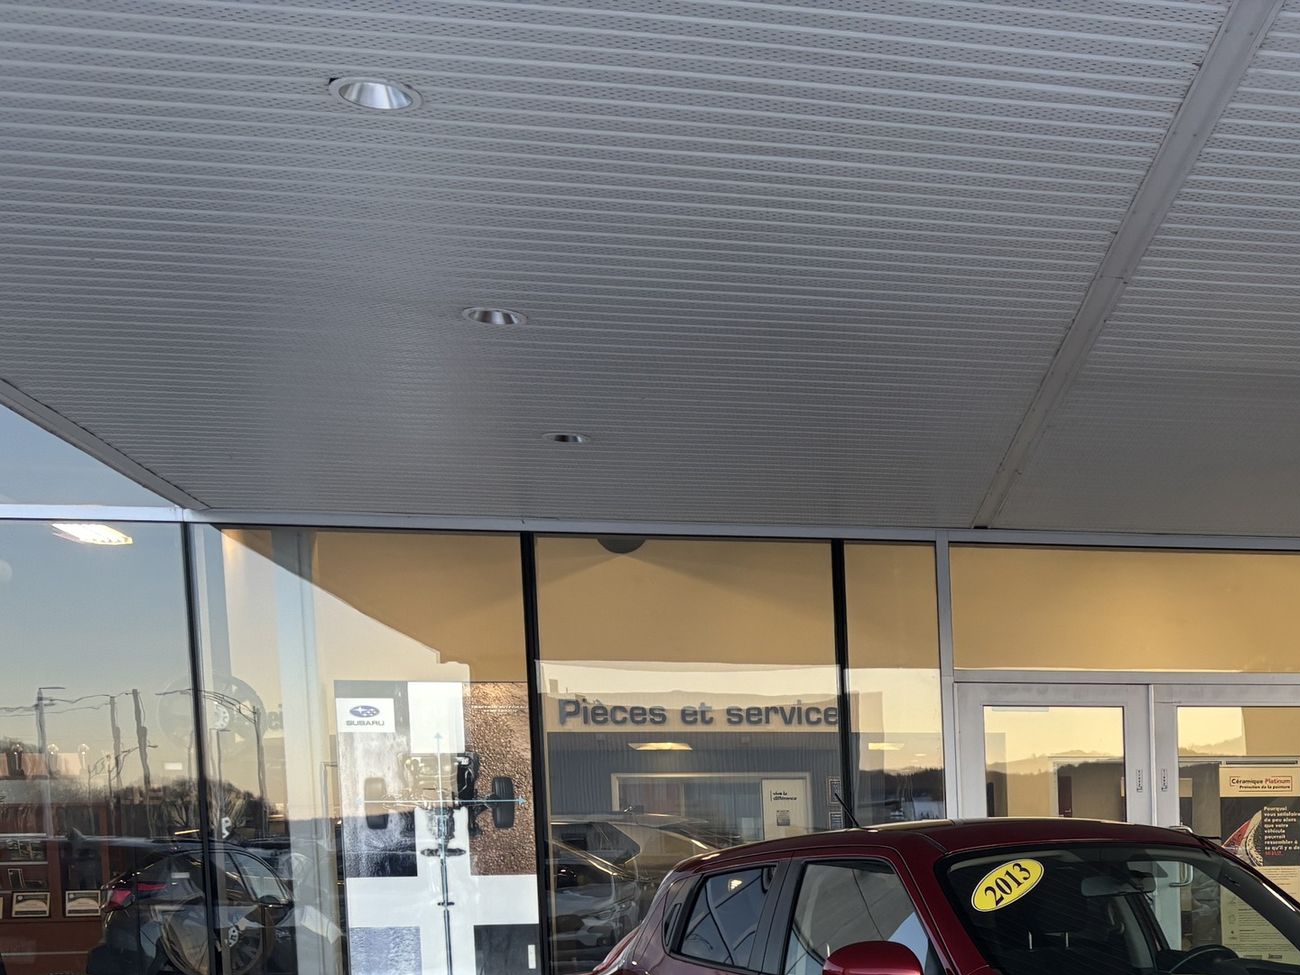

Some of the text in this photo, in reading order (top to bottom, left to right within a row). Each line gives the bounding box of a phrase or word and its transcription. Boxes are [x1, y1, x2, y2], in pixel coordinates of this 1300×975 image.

[557, 698, 667, 726] Pièces
[680, 701, 714, 725] et
[984, 863, 1031, 906] 2013
